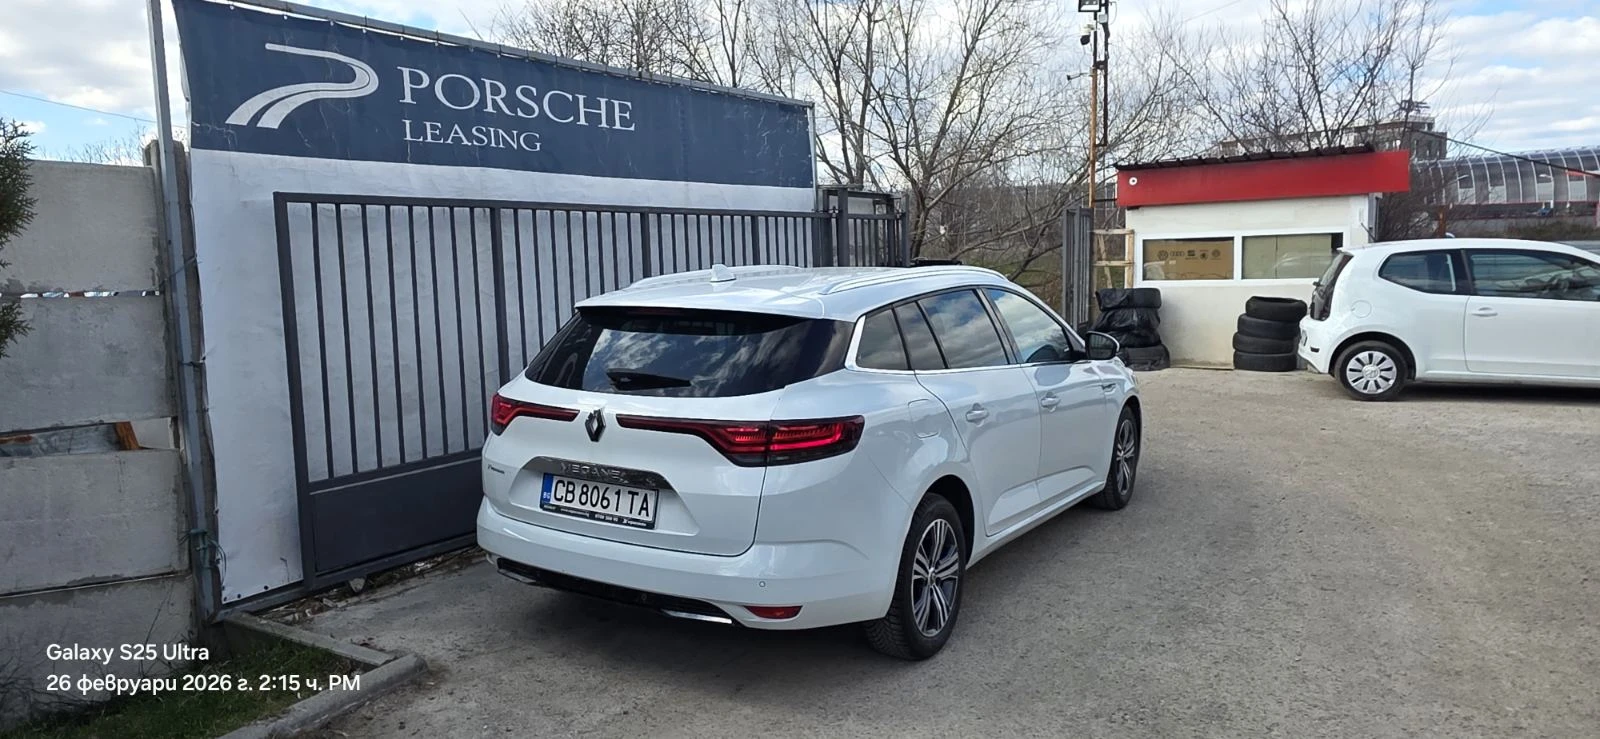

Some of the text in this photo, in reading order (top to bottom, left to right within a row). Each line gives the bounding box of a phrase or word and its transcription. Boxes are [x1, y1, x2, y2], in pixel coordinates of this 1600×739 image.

[397, 66, 636, 131] PORSCHE
[403, 119, 542, 152] LEASING
[553, 479, 650, 517] CB 8061 TA
